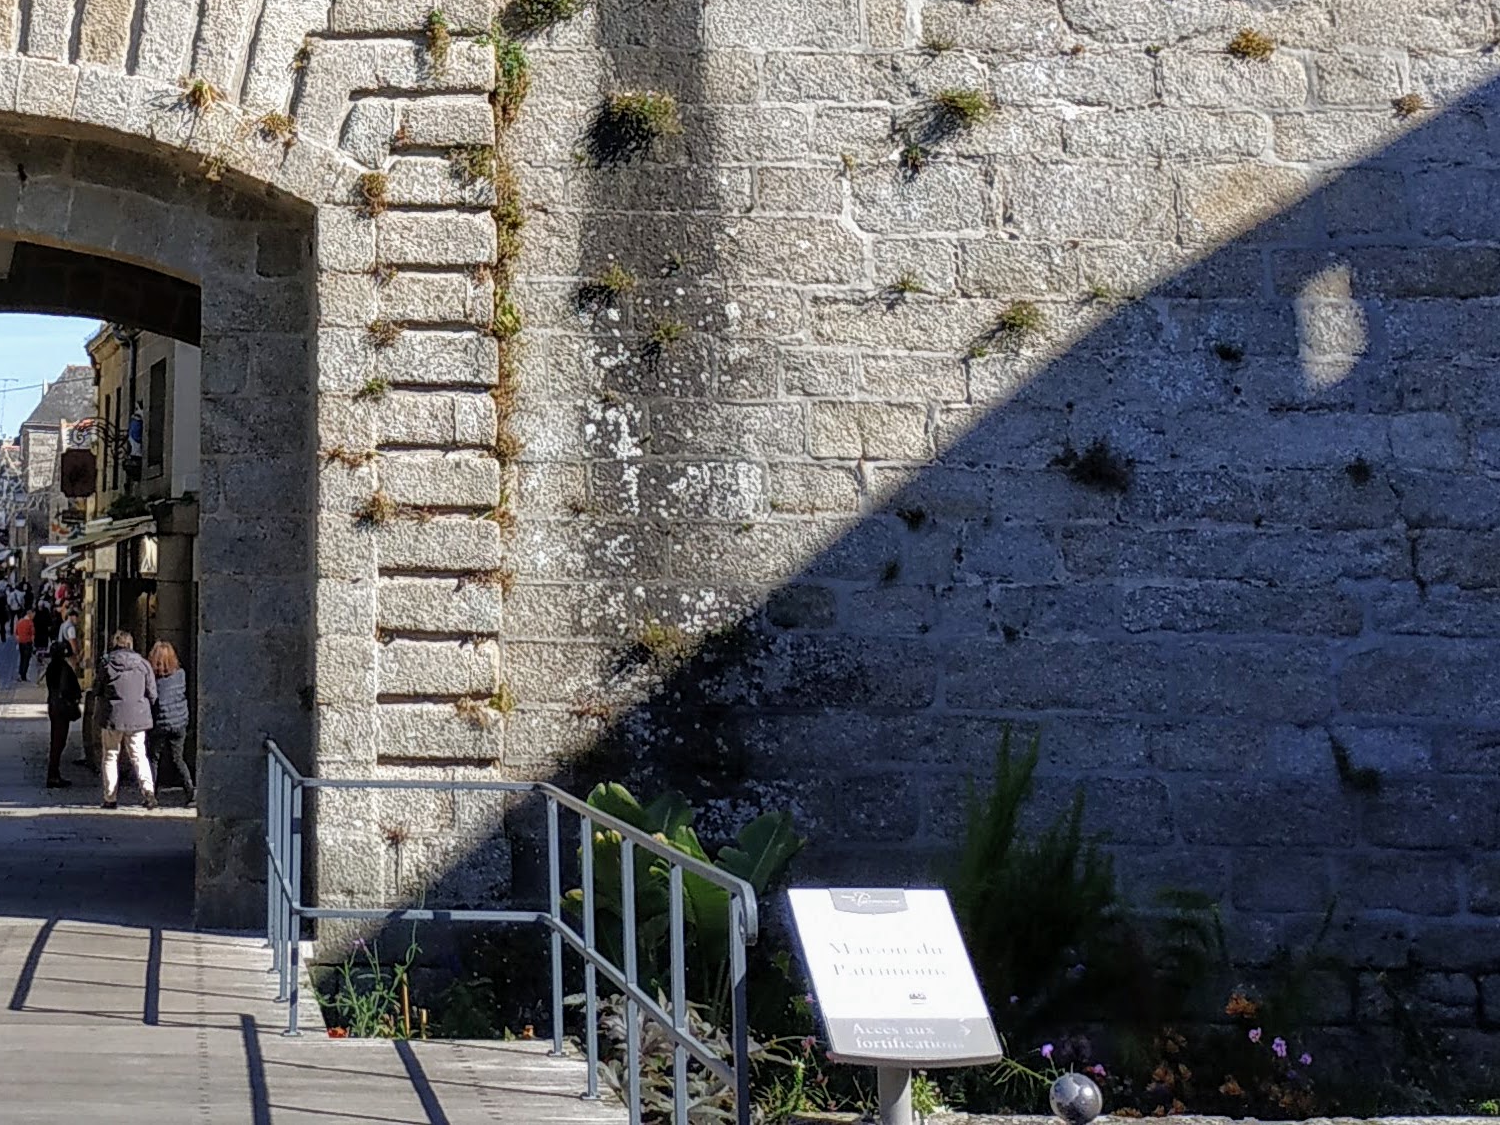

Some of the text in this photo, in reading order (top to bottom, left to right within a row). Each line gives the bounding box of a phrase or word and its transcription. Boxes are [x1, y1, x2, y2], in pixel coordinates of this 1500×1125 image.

[829, 942, 943, 955] Maison du
[833, 963, 946, 976] Patrimoine
[905, 1026, 936, 1035] aux
[856, 1036, 965, 1049] fortifications
